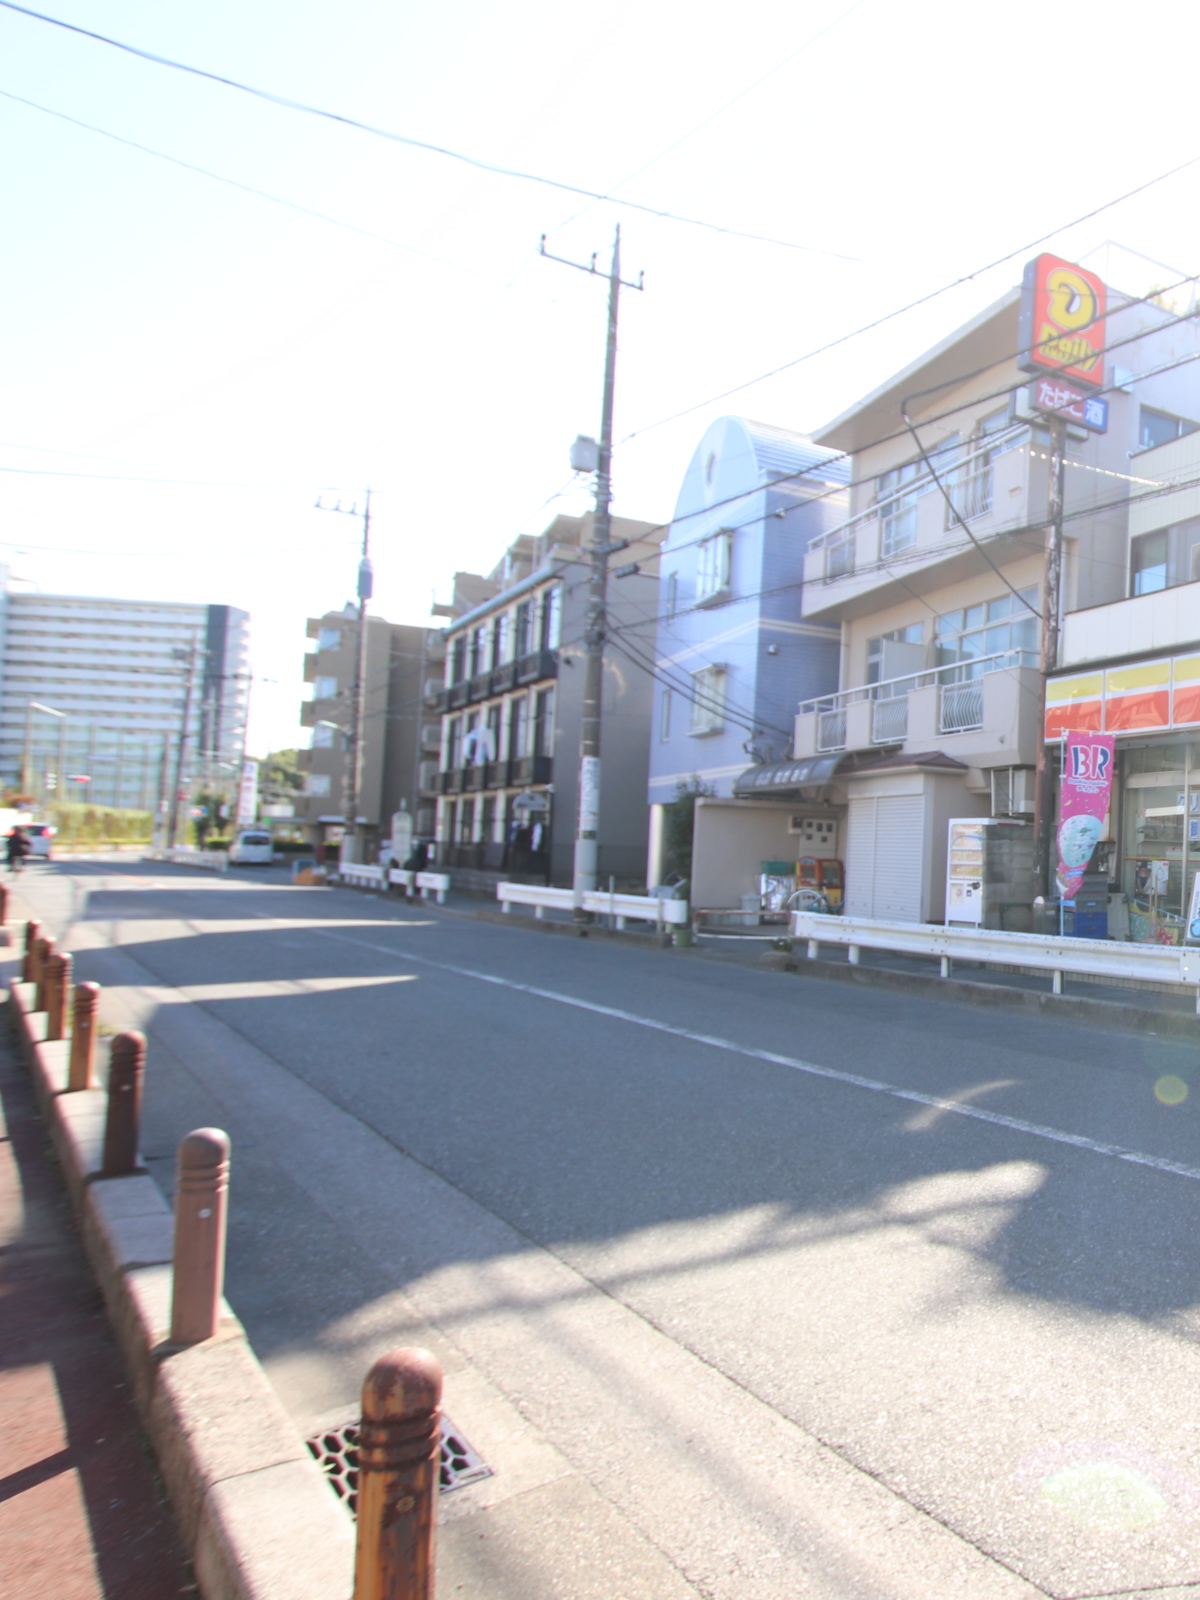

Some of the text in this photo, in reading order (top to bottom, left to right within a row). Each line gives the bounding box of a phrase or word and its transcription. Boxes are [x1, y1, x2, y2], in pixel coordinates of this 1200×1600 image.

[1040, 382, 1105, 426] たばこ 酒
[1071, 745, 1110, 778] BR
